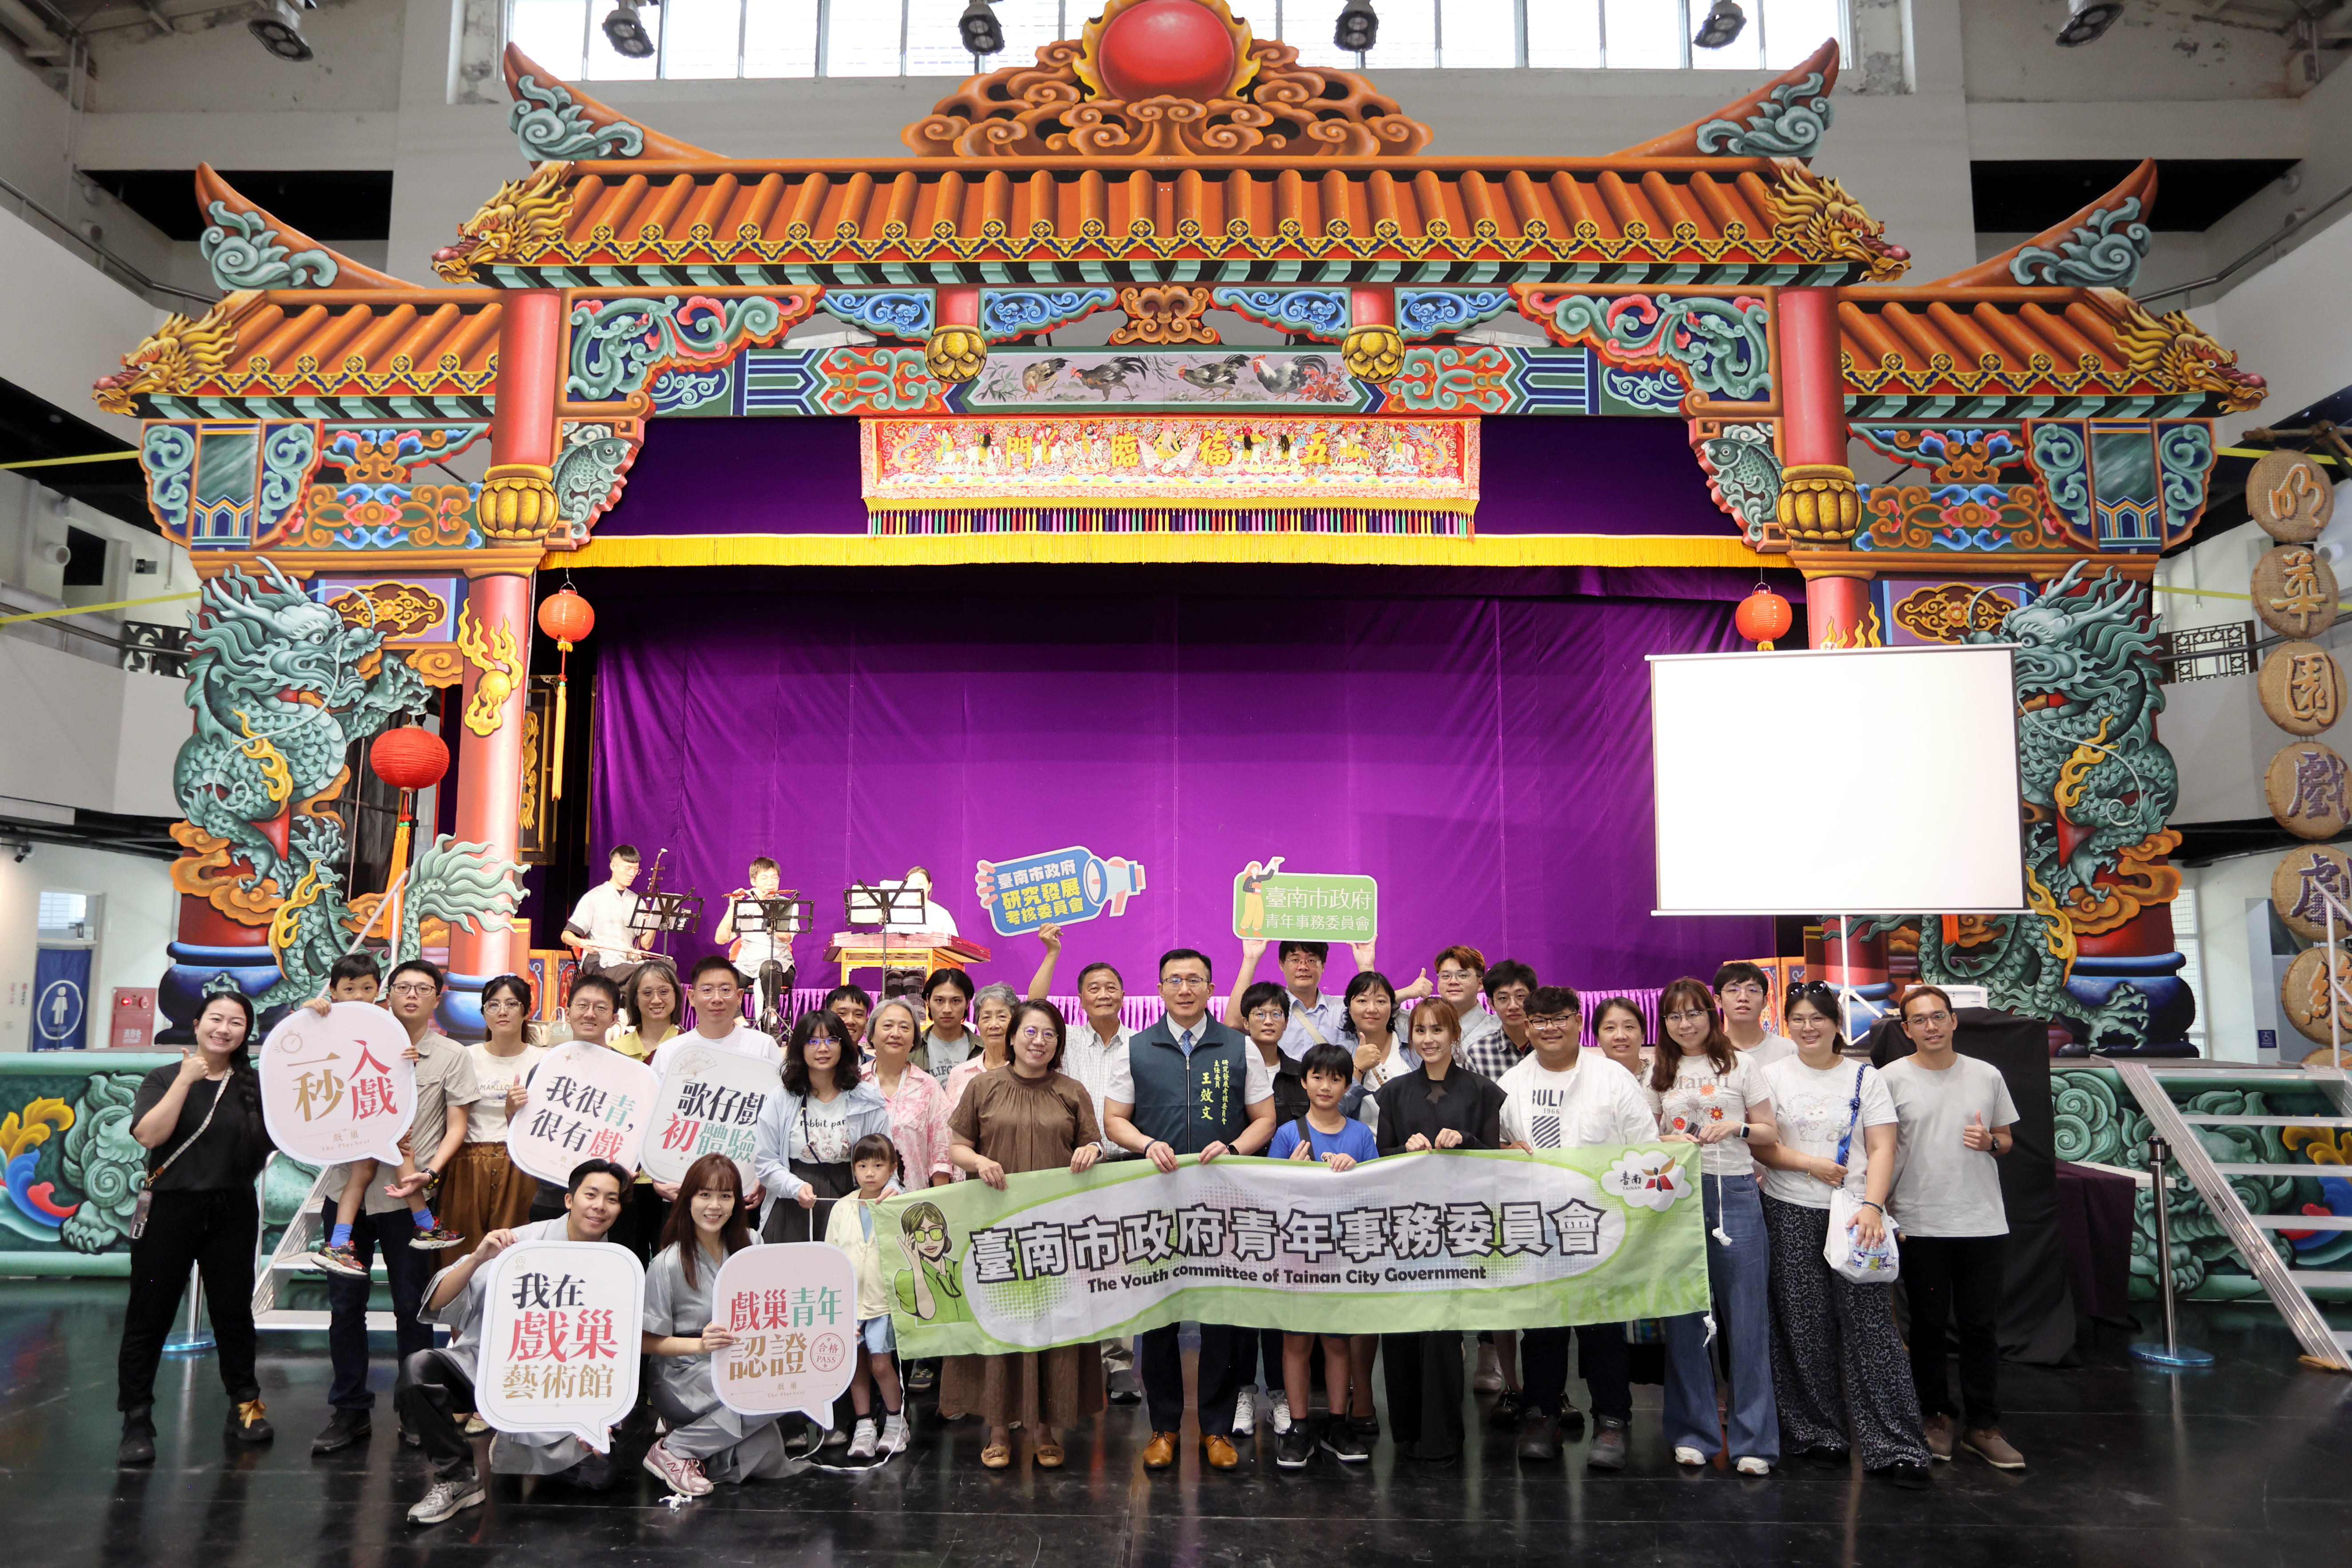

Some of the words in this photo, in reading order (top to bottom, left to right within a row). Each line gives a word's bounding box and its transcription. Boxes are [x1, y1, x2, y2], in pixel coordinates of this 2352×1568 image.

[2269, 463, 2352, 1068] 明華園戲劇總
[997, 859, 1076, 889] 臺南市政府
[1001, 877, 1081, 910] 研究發展
[1005, 897, 1084, 925] 考核委員會
[1265, 886, 1372, 910] 臺南市政府
[1265, 913, 1370, 931] 青年事務委員會
[287, 1052, 345, 1122] 一秒
[348, 1040, 398, 1122] 入戲
[677, 1081, 767, 1126] 歌仔戲
[1200, 1072, 1214, 1120] 王效文
[529, 1108, 624, 1165] 很有戲
[659, 1112, 756, 1164] 初體驗
[1620, 1170, 1641, 1185] 臺南
[970, 1198, 1607, 1283] 臺南市政府青年事務委員會
[512, 1272, 586, 1310] 我在
[1088, 1278, 1117, 1293] The
[1121, 1268, 1169, 1290] Youth
[1173, 1264, 1258, 1281] committee
[1262, 1269, 1279, 1283] of
[1284, 1269, 1341, 1284] Tainan
[1346, 1269, 1380, 1285] City
[1385, 1266, 1486, 1282] Government
[729, 1286, 843, 1331] 戲巢青年
[506, 1309, 618, 1362] 戲巢
[730, 1332, 808, 1380] 認證
[818, 1342, 839, 1354] 合格
[502, 1363, 613, 1400] 藝術館
